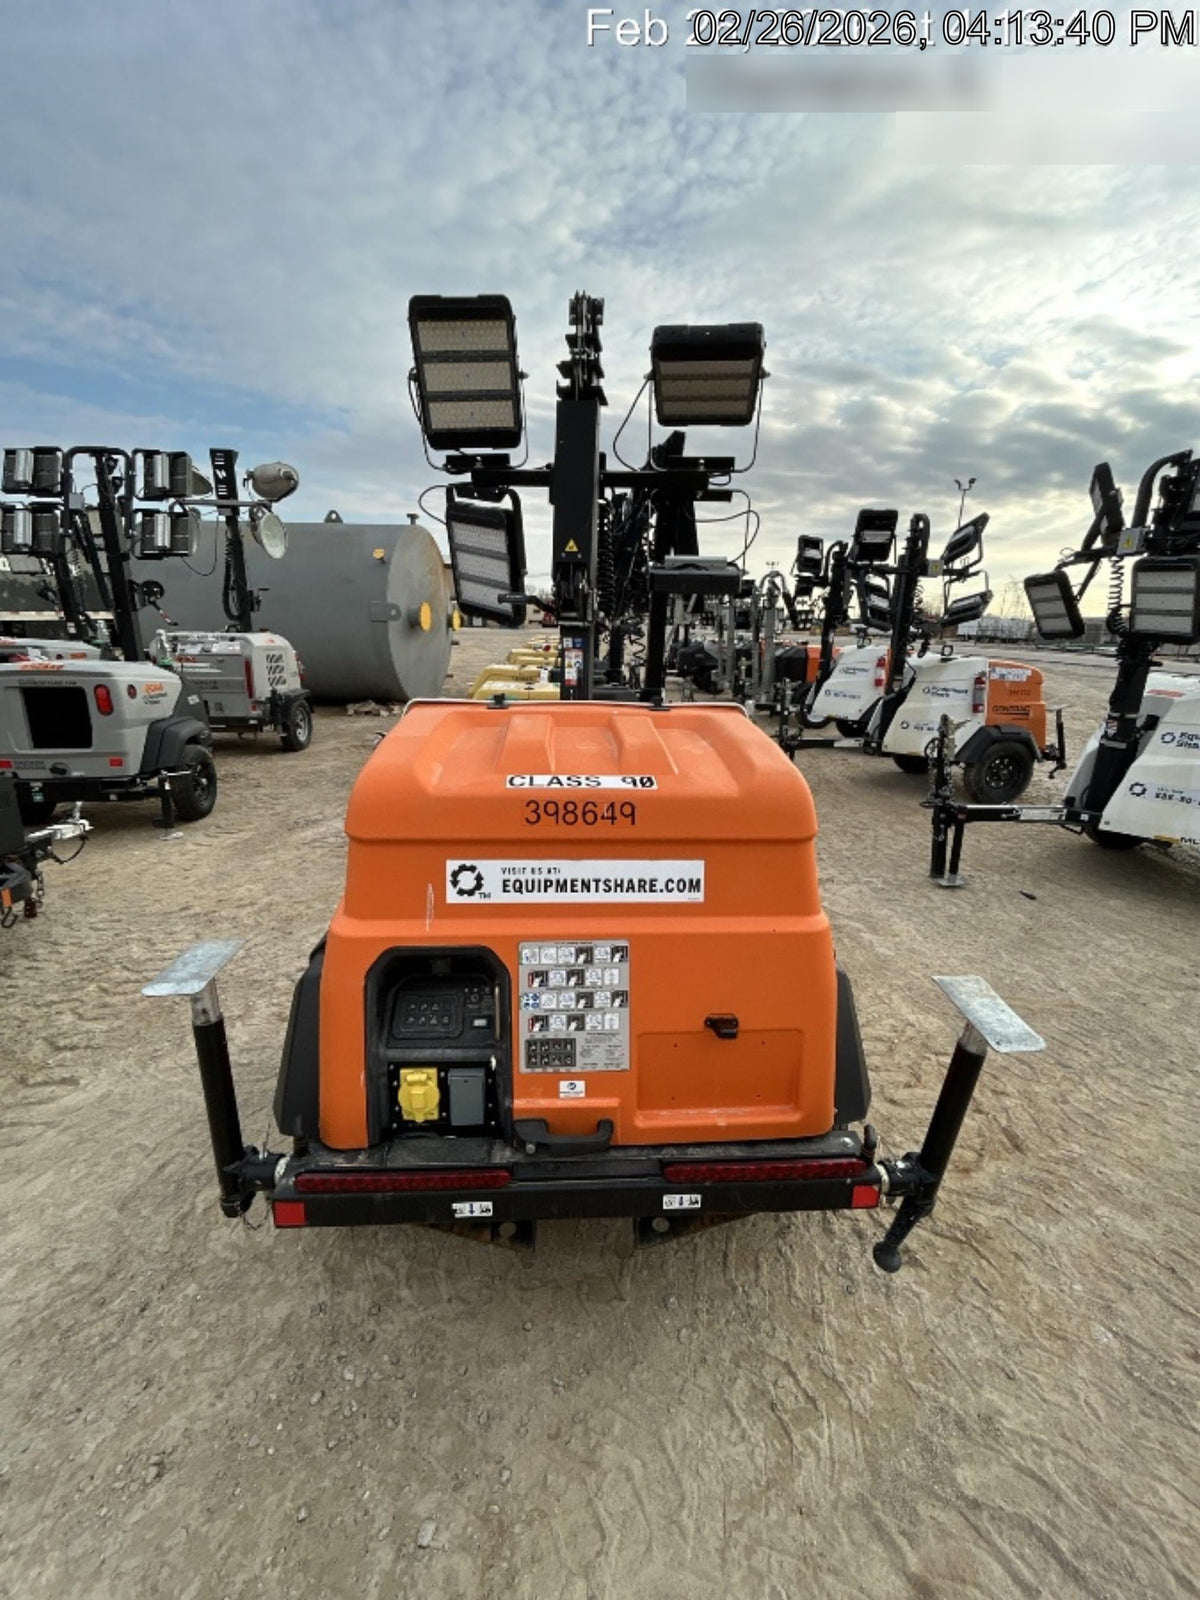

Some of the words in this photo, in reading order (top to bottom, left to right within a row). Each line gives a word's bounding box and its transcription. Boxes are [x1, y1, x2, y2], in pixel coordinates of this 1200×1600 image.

[508, 776, 602, 787] CLASS
[524, 799, 637, 826] 398649
[501, 867, 528, 875] VISIT
[502, 877, 702, 895] EQUIPMENTSHARE.COM
